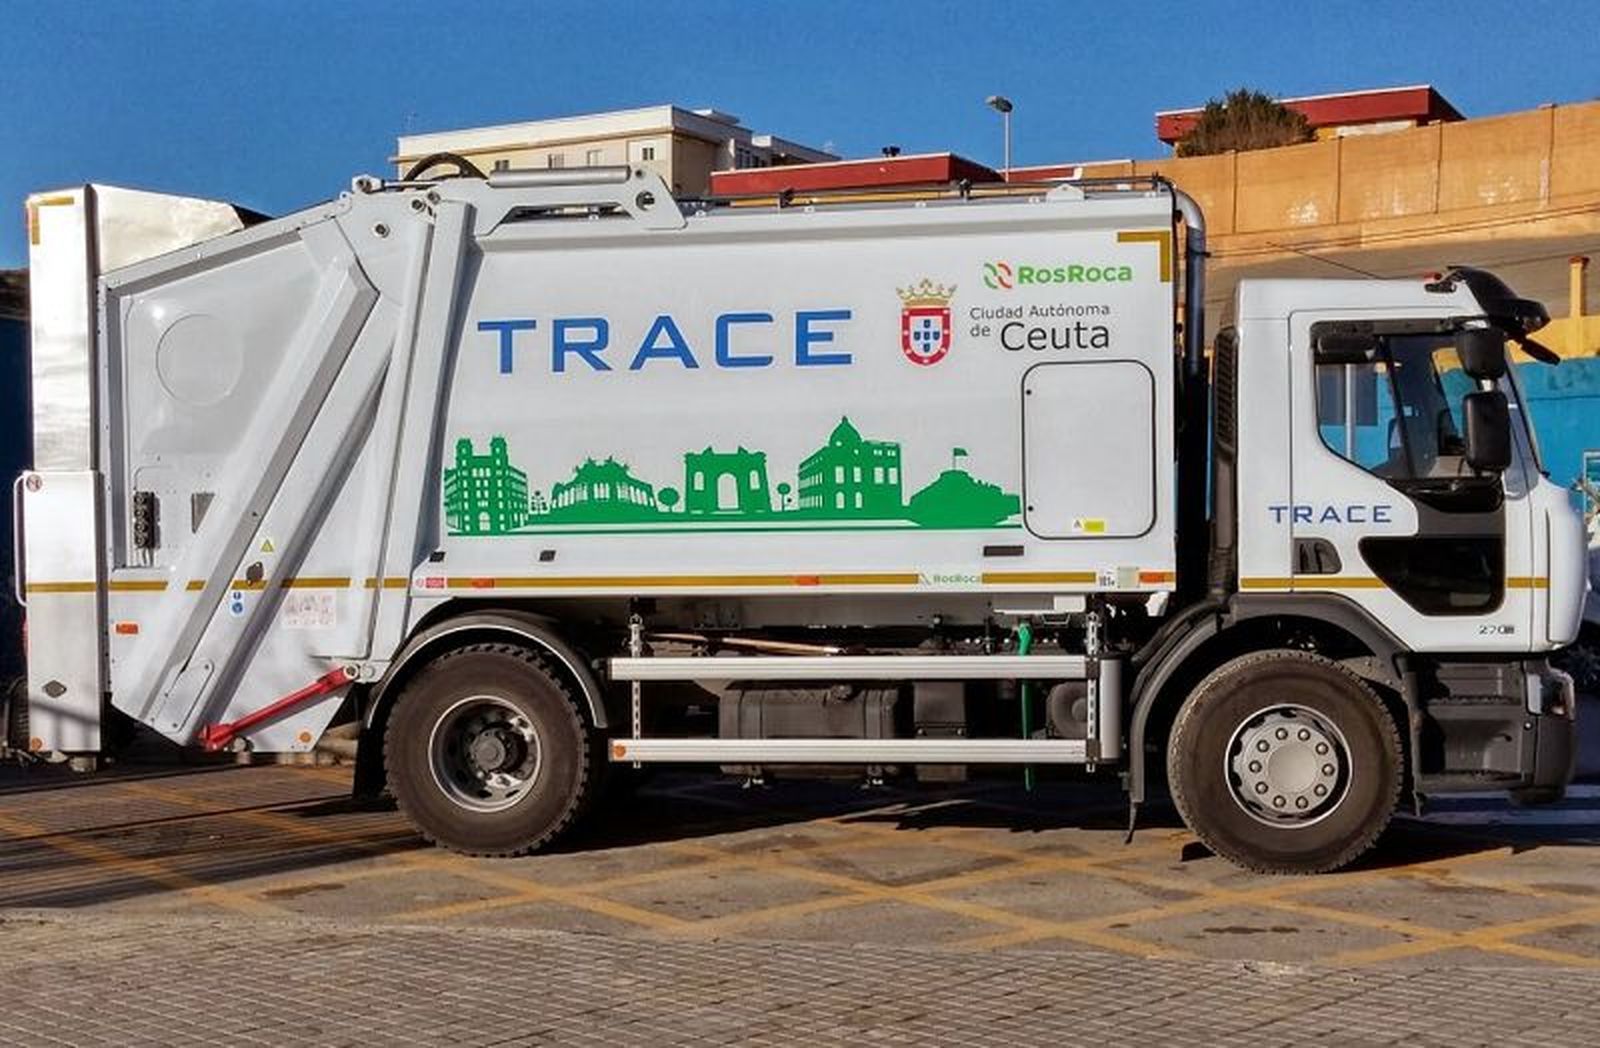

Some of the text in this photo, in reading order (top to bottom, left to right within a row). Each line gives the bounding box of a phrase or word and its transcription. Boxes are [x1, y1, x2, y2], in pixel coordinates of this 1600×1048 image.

[1018, 265, 1133, 284] RosRoca
[970, 304, 1110, 320] Ciudad Autónoma
[477, 310, 852, 374] TRACE
[970, 321, 1110, 351] de Ceuta
[1268, 505, 1392, 523] TRACE
